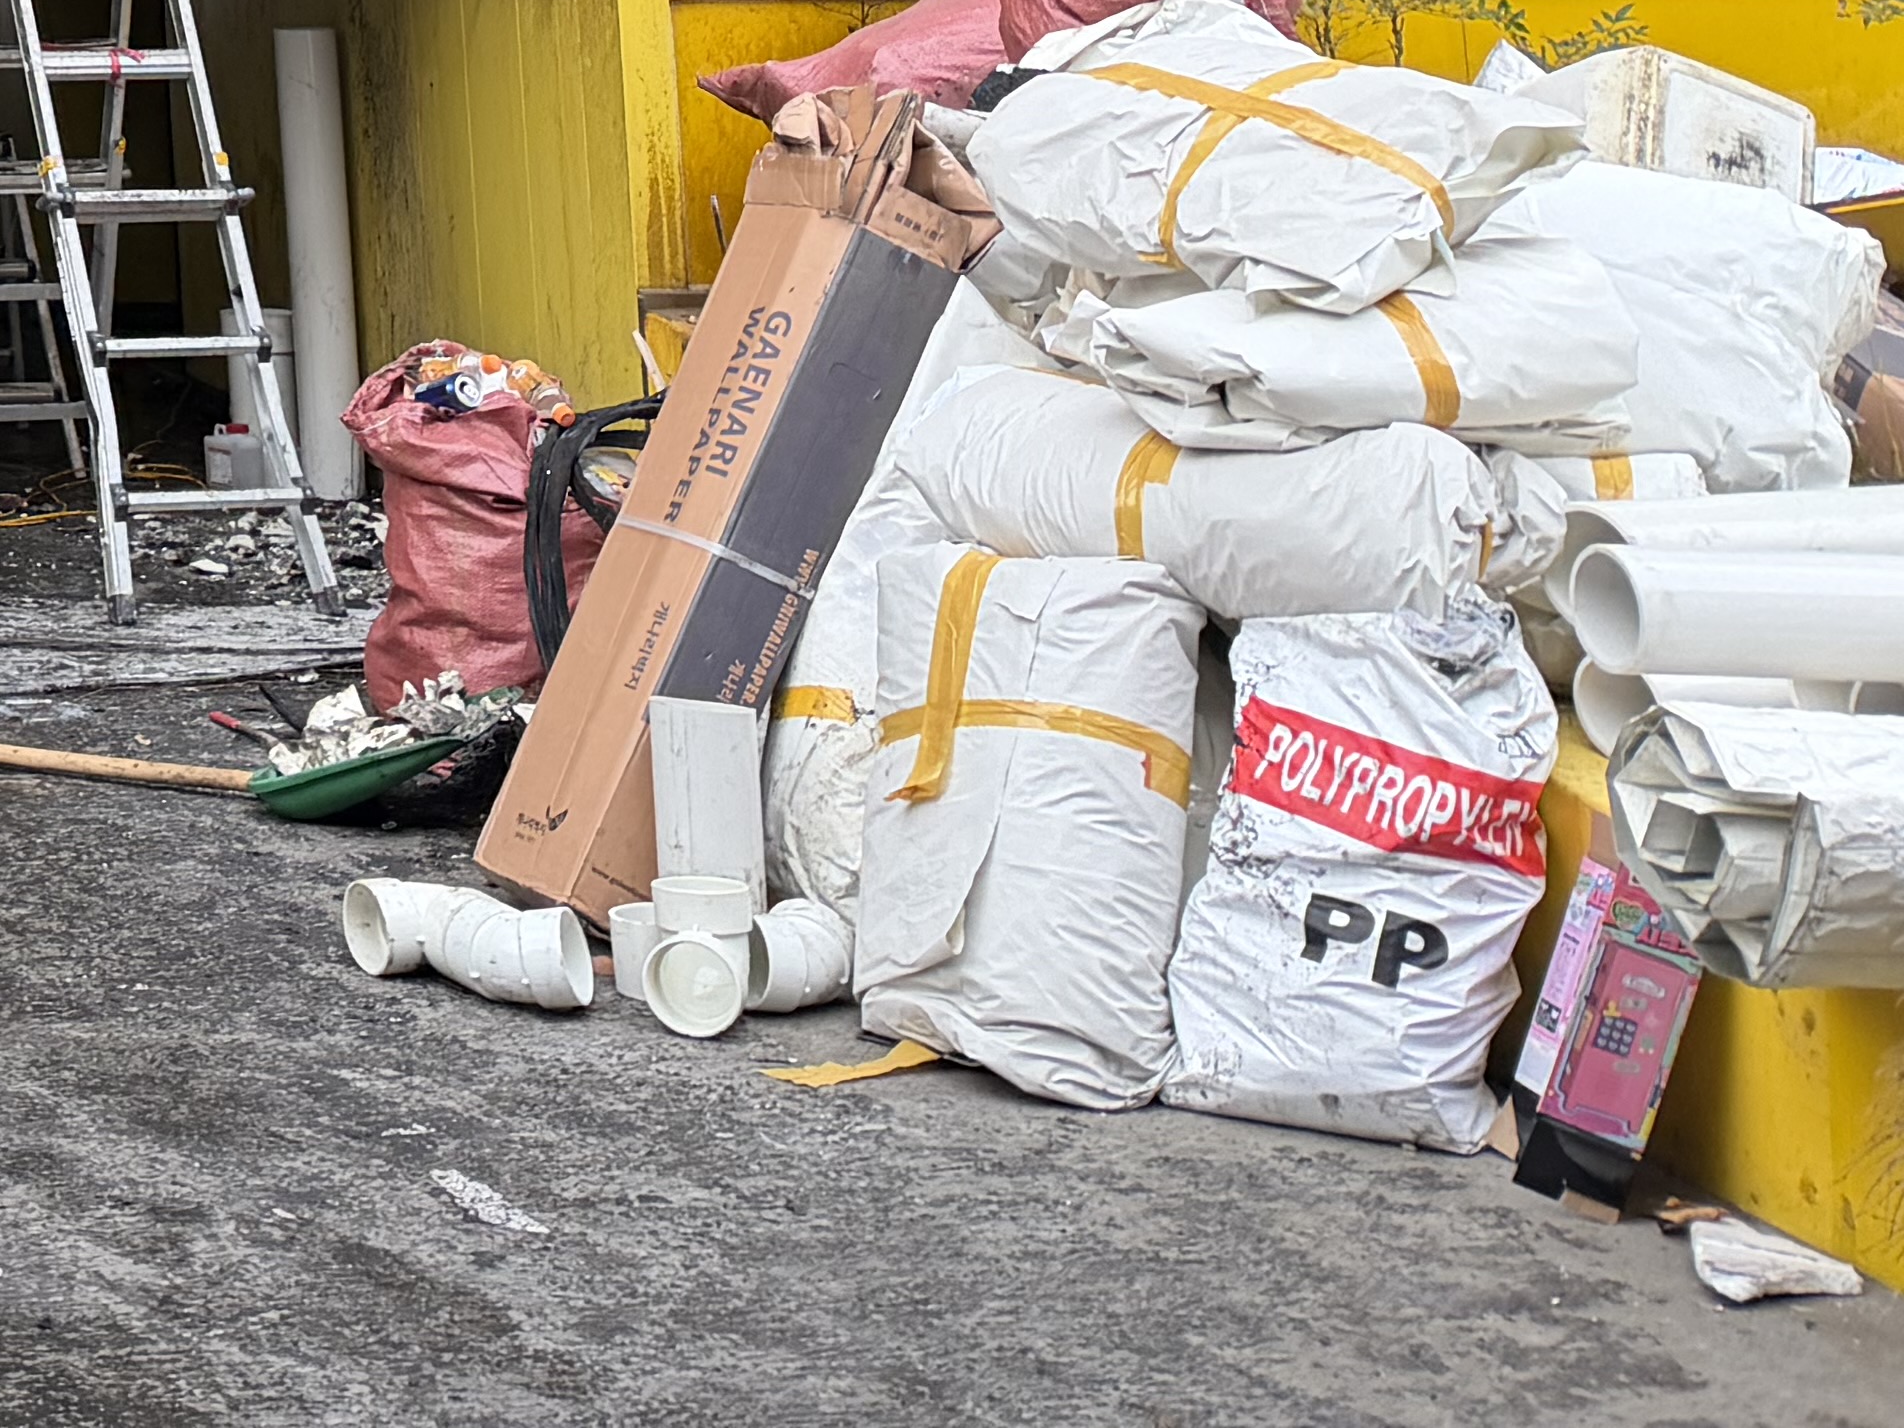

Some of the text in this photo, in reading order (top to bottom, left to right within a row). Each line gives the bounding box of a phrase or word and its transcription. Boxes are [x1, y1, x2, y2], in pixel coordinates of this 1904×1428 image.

[664, 306, 766, 522] WALLPAPER
[705, 311, 792, 479] GAENARI
[624, 601, 670, 690] 개나리벽지
[1300, 893, 1449, 988] PP
